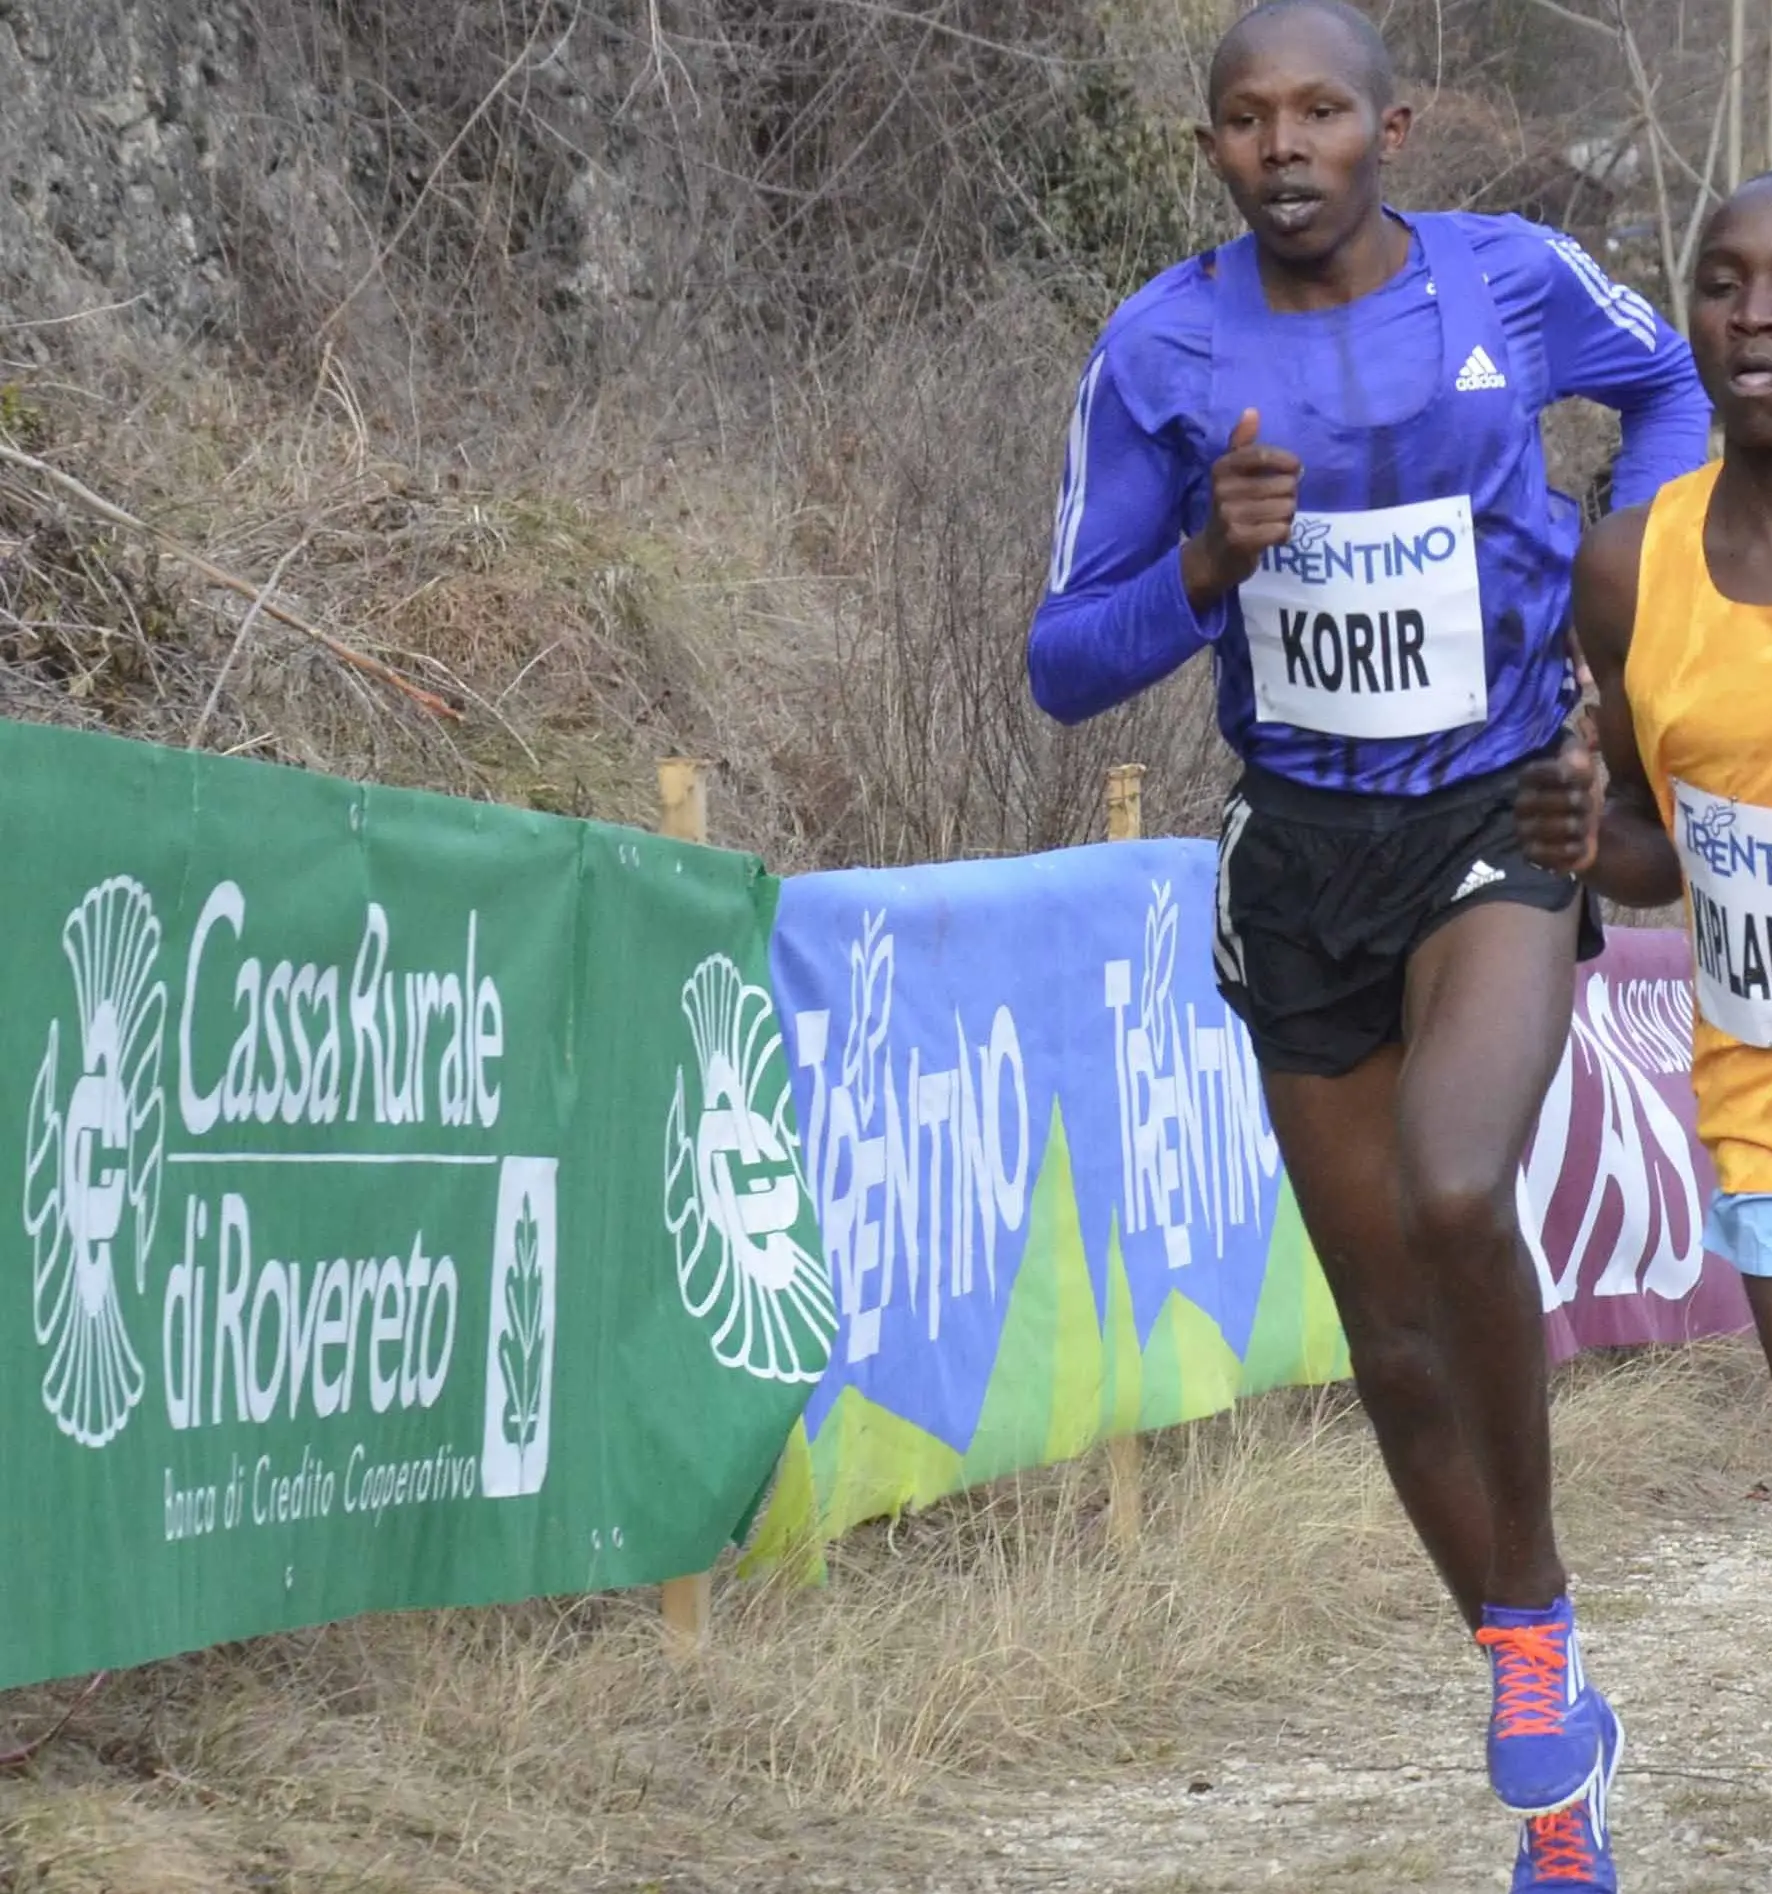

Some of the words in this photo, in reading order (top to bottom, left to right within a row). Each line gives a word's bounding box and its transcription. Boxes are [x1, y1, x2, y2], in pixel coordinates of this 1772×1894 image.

[1456, 372, 1506, 391] adidas
[1279, 608, 1431, 693] KORIR
[178, 880, 341, 1134] Cassa
[346, 902, 504, 1128] Rurale
[796, 1001, 1030, 1364] TRENTINO
[212, 1193, 458, 1424] Rovereto
[224, 1451, 246, 1530] di
[253, 1442, 336, 1526] Credito
[344, 1442, 477, 1529] Cooperativo
